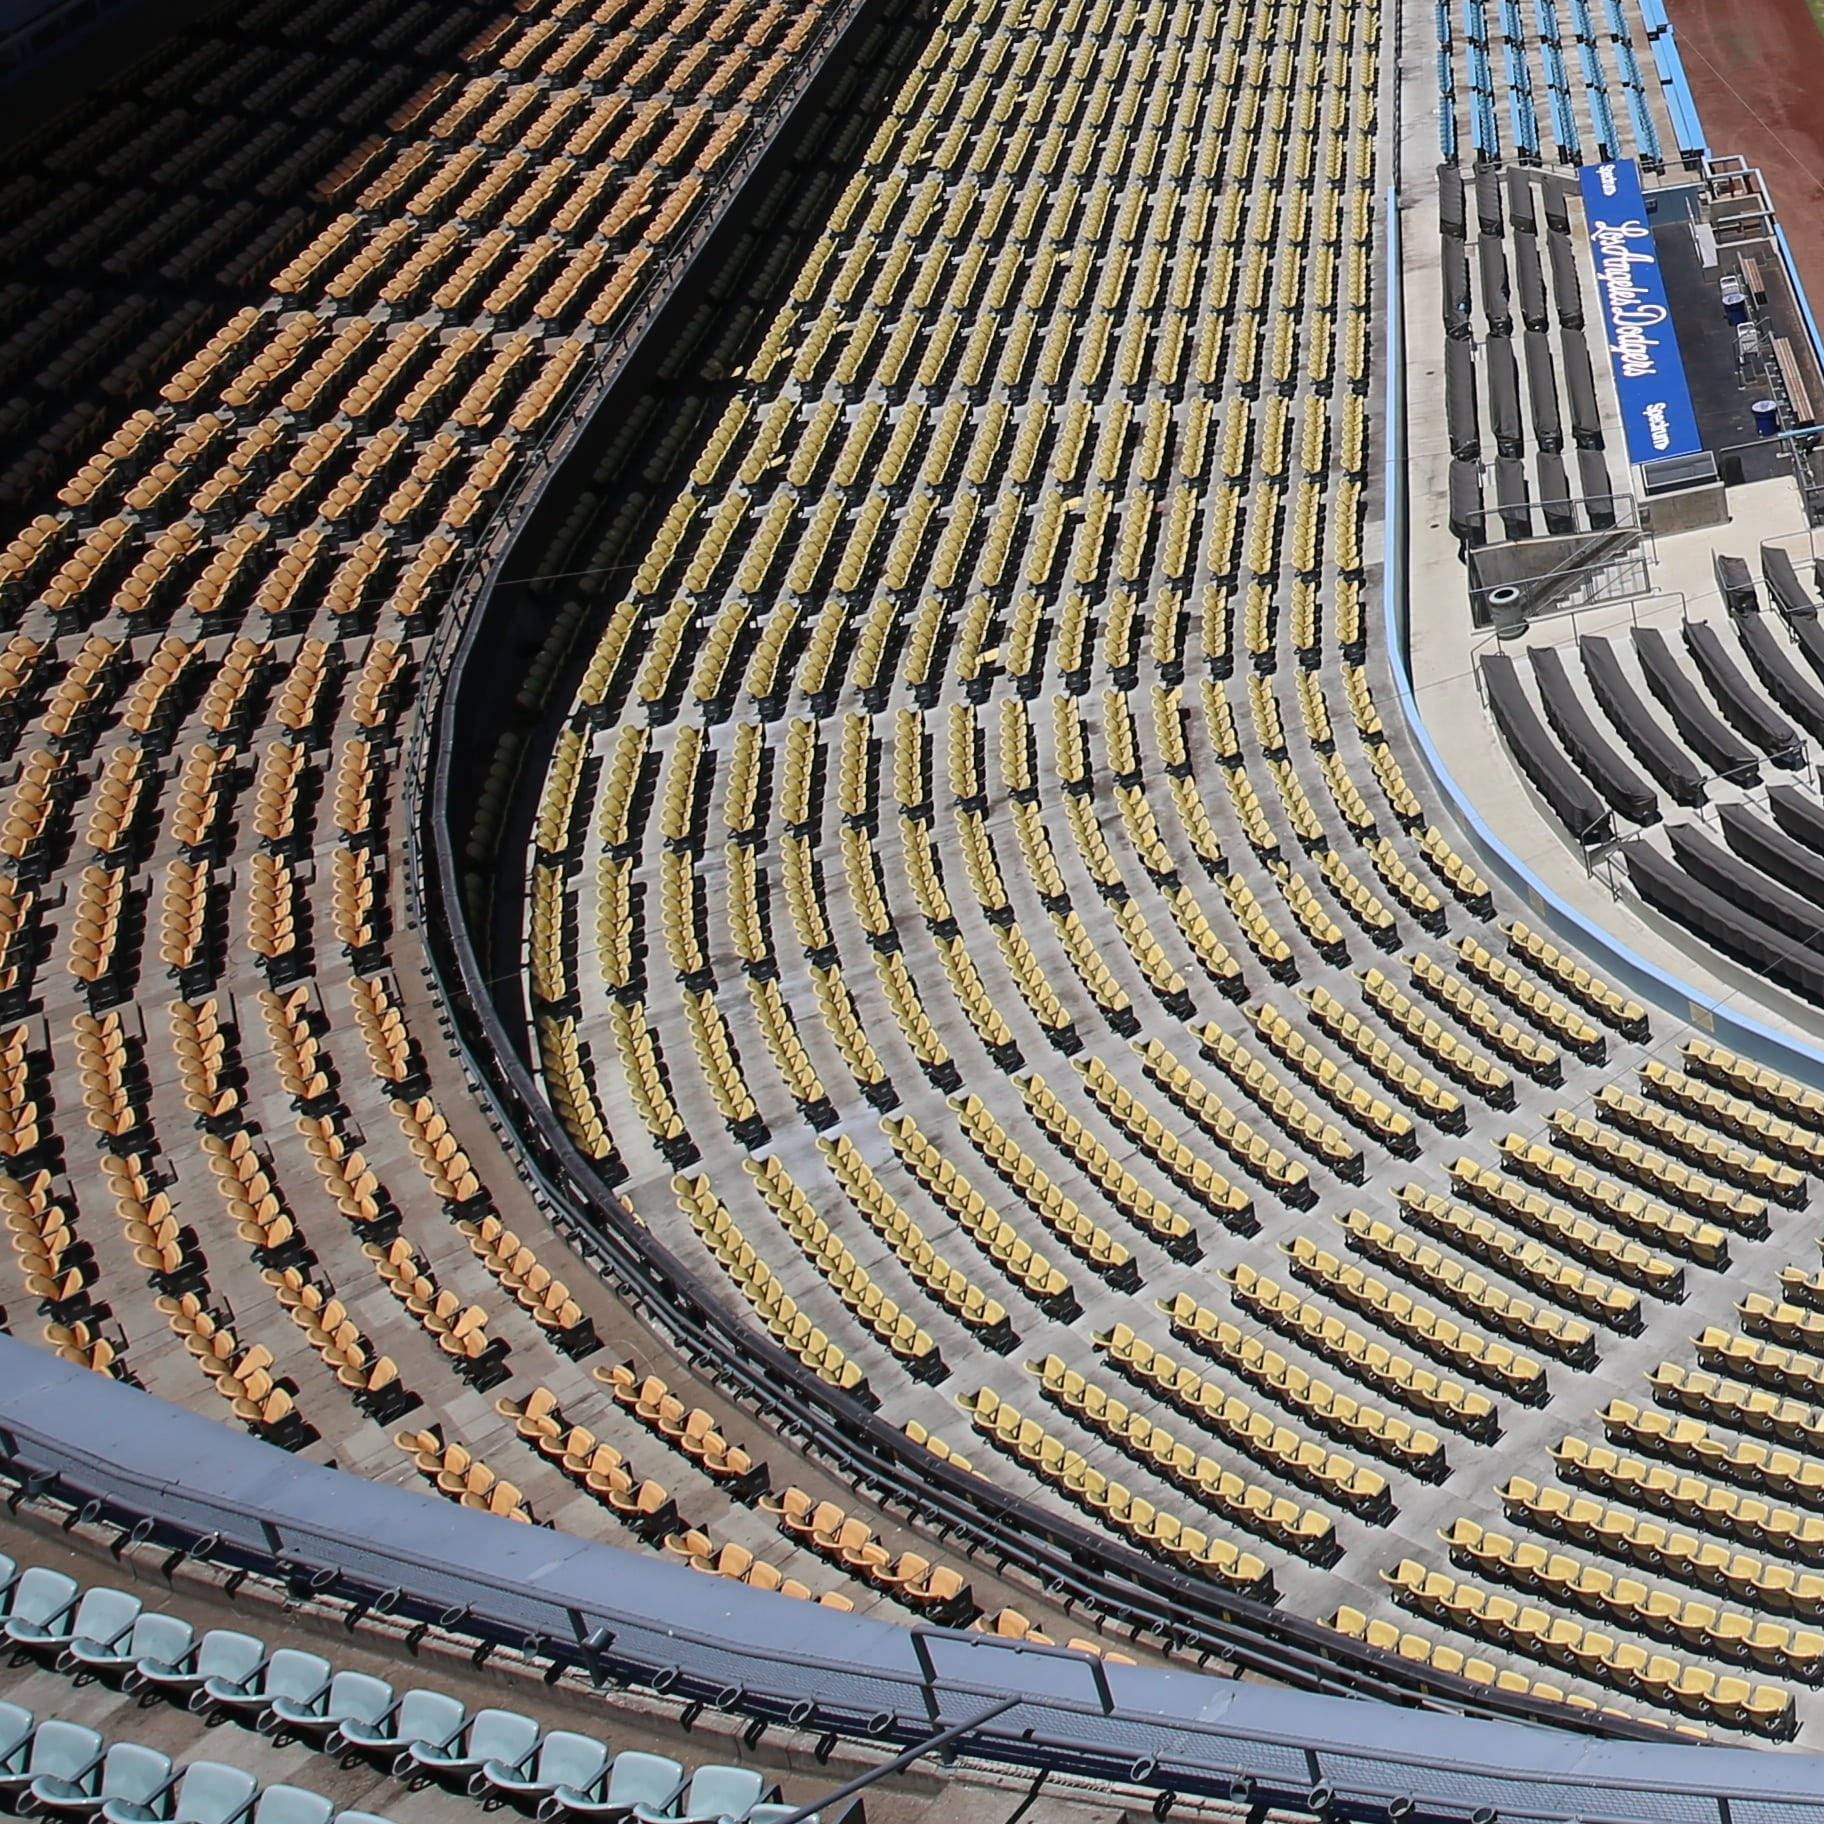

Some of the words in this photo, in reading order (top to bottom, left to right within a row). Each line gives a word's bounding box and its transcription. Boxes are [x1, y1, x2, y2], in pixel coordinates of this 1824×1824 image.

[1597, 243, 1656, 311] Angeles
[1610, 303, 1667, 377] Dodgers
[1642, 402, 1670, 447] Spectrum
